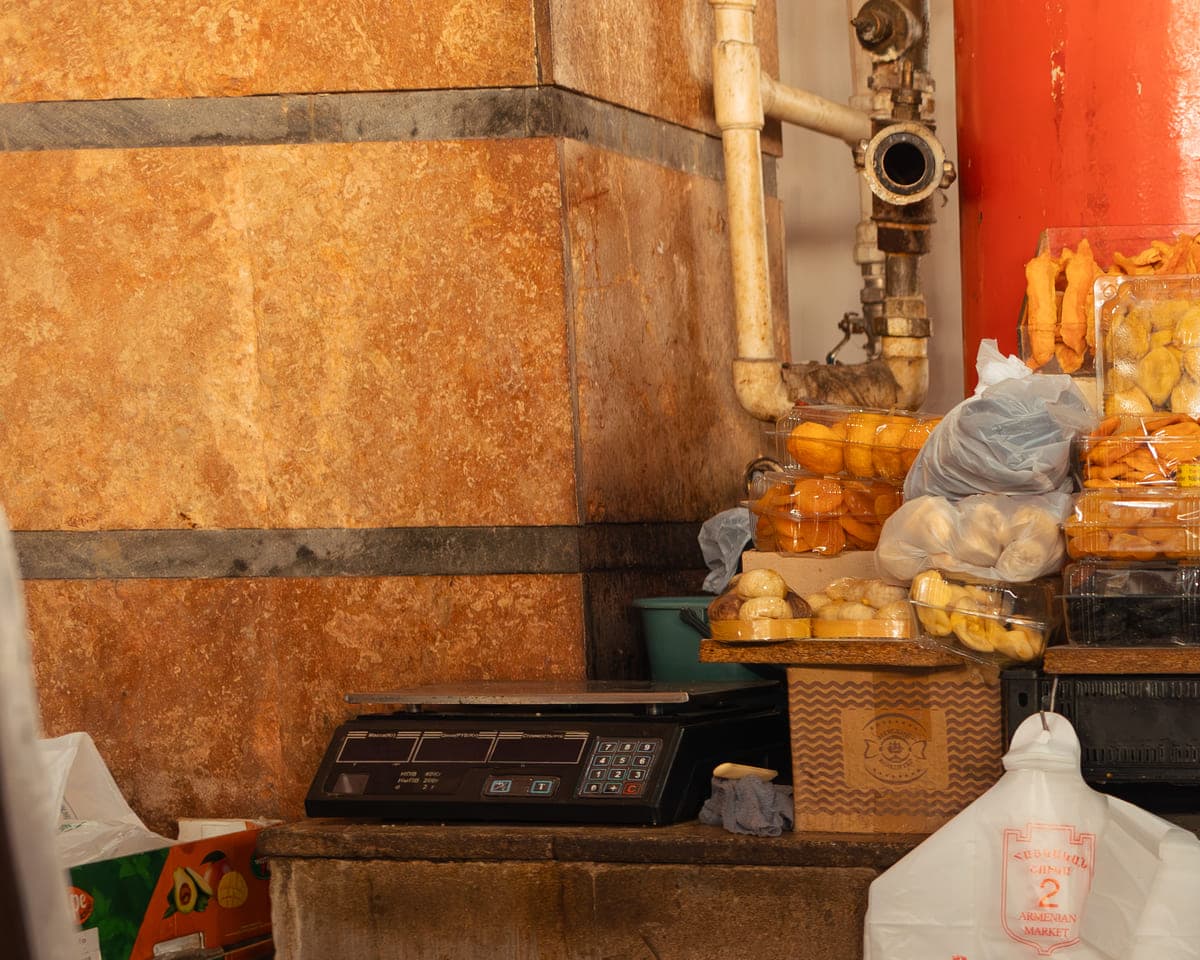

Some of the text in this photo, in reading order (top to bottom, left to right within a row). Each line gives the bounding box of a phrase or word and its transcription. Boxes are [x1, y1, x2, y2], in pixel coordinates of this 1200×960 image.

[1038, 878, 1060, 908] 2
[1019, 911, 1078, 923] ARMENIAN
[1024, 926, 1069, 937] MARKET
